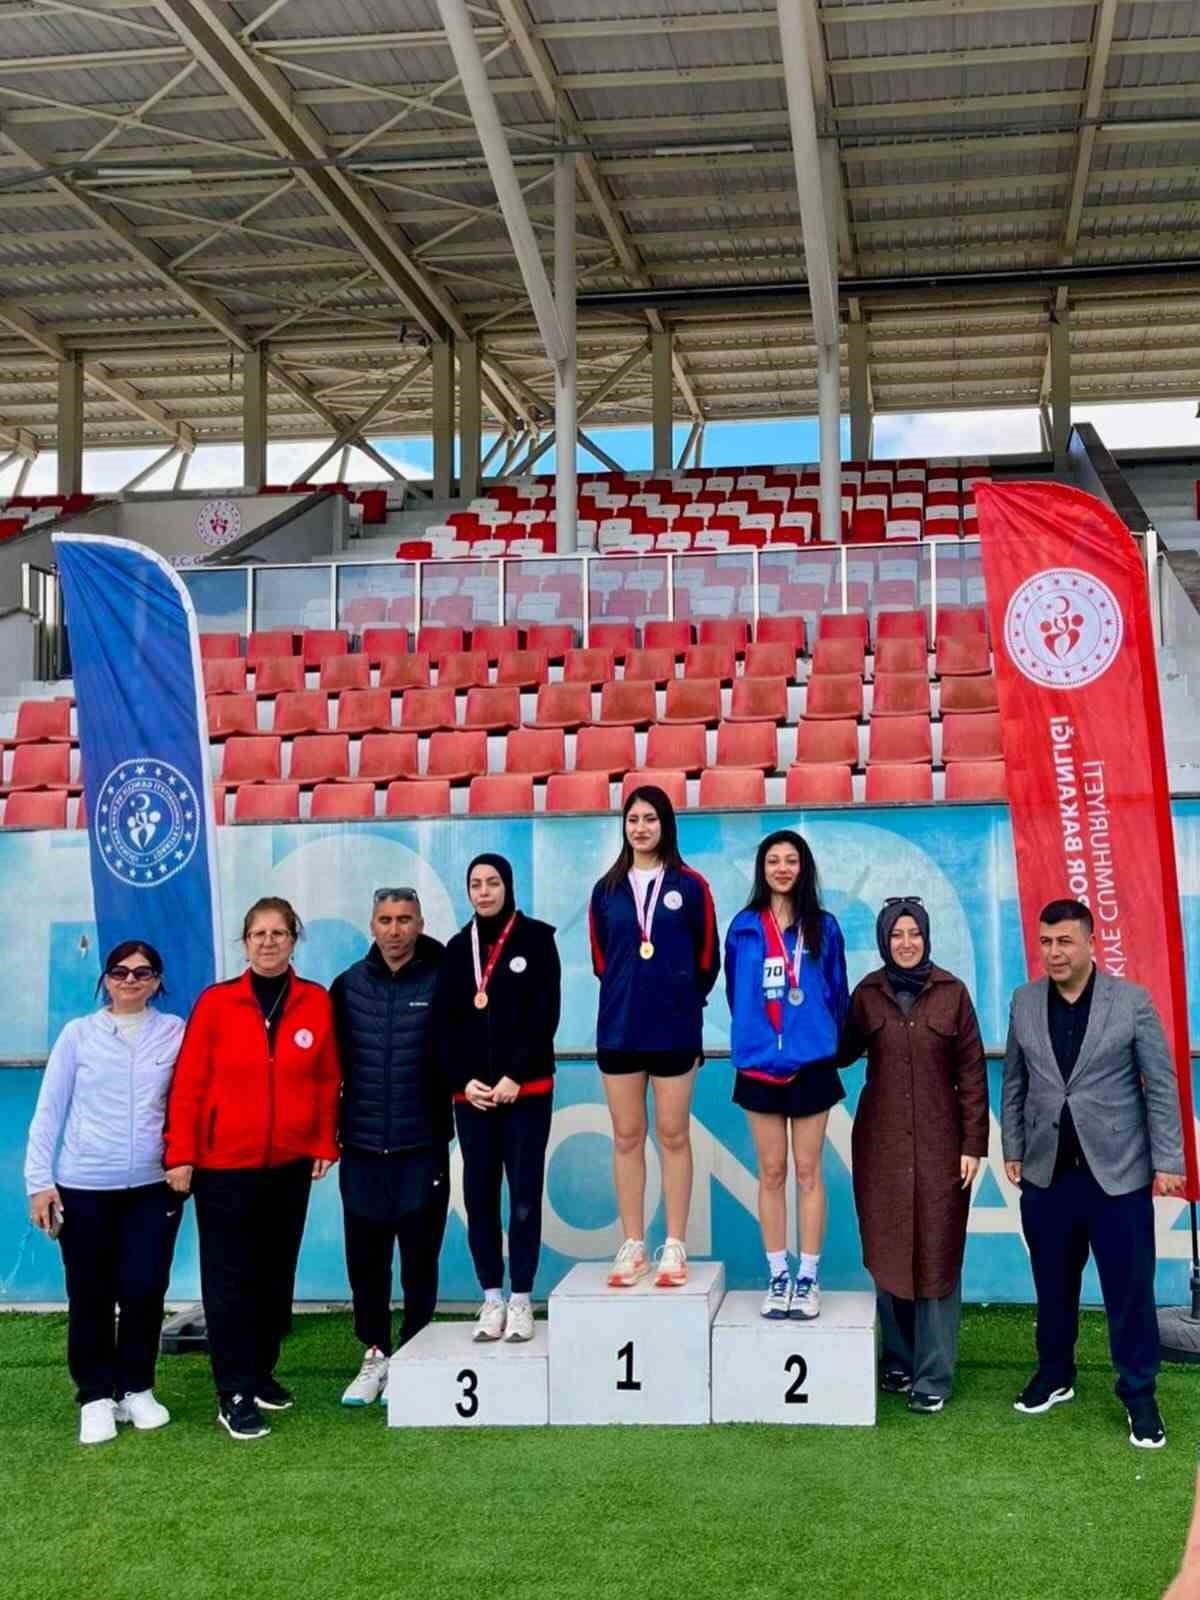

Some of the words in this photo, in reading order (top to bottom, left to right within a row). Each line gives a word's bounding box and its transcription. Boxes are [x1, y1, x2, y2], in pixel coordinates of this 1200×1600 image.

[616, 1341, 641, 1391] 1
[784, 1354, 809, 1403] 2
[455, 1368, 479, 1418] 3
